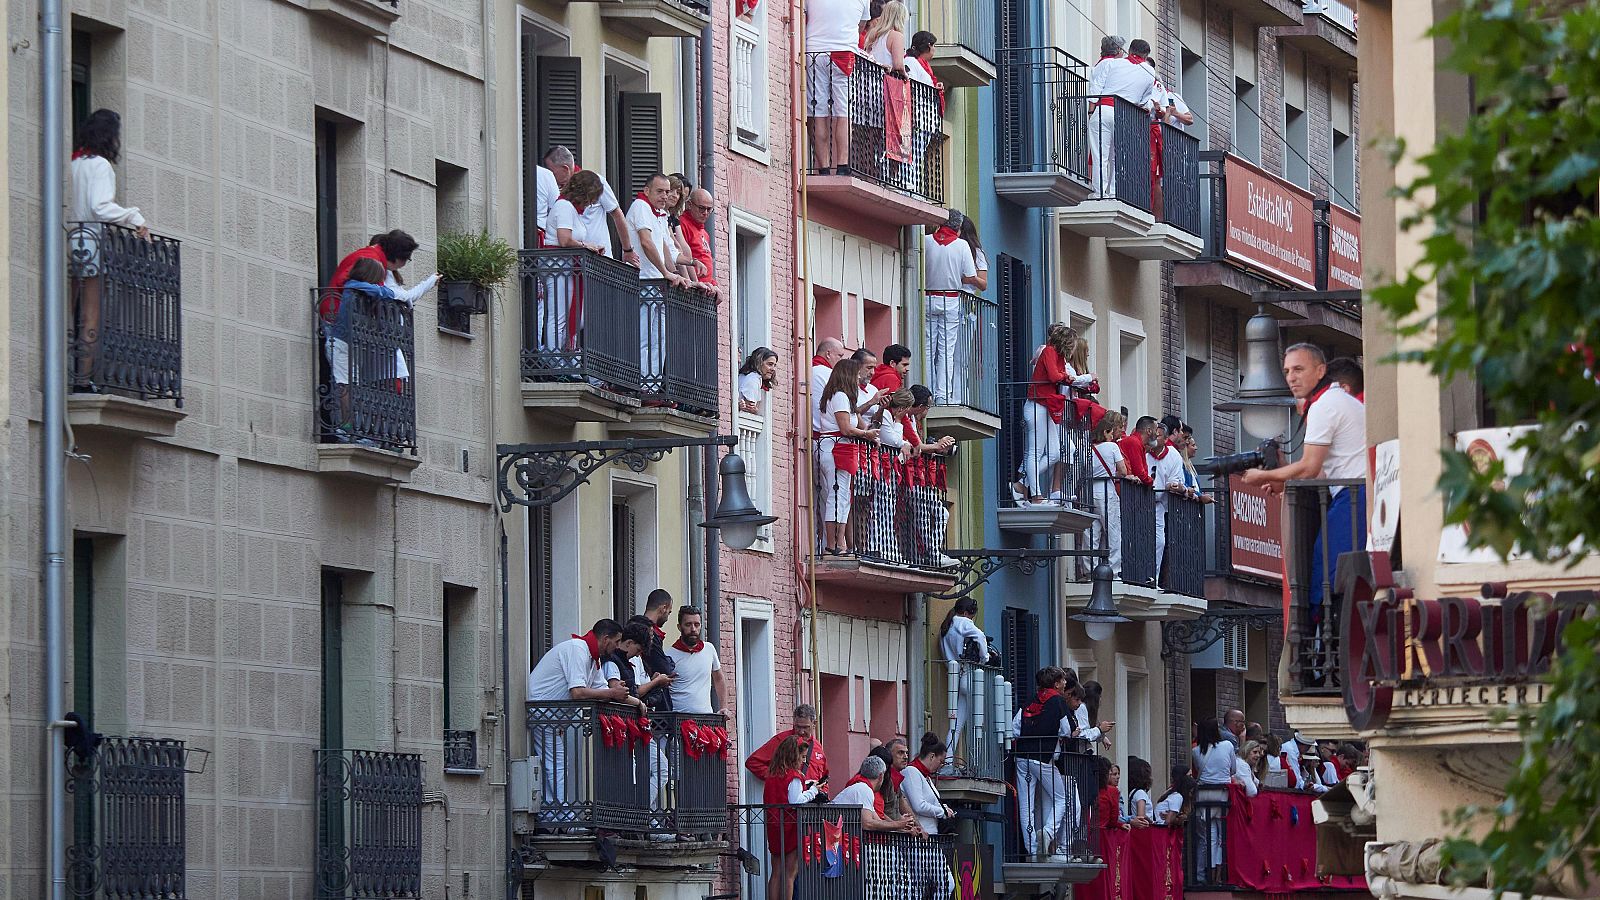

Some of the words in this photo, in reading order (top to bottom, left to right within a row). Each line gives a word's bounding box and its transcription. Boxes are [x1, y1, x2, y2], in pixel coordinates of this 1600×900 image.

[1248, 181, 1275, 225] Estafeta
[1275, 194, 1293, 233] 60-62
[1232, 490, 1267, 527] 948206696
[1403, 684, 1543, 708] CERVECERI
